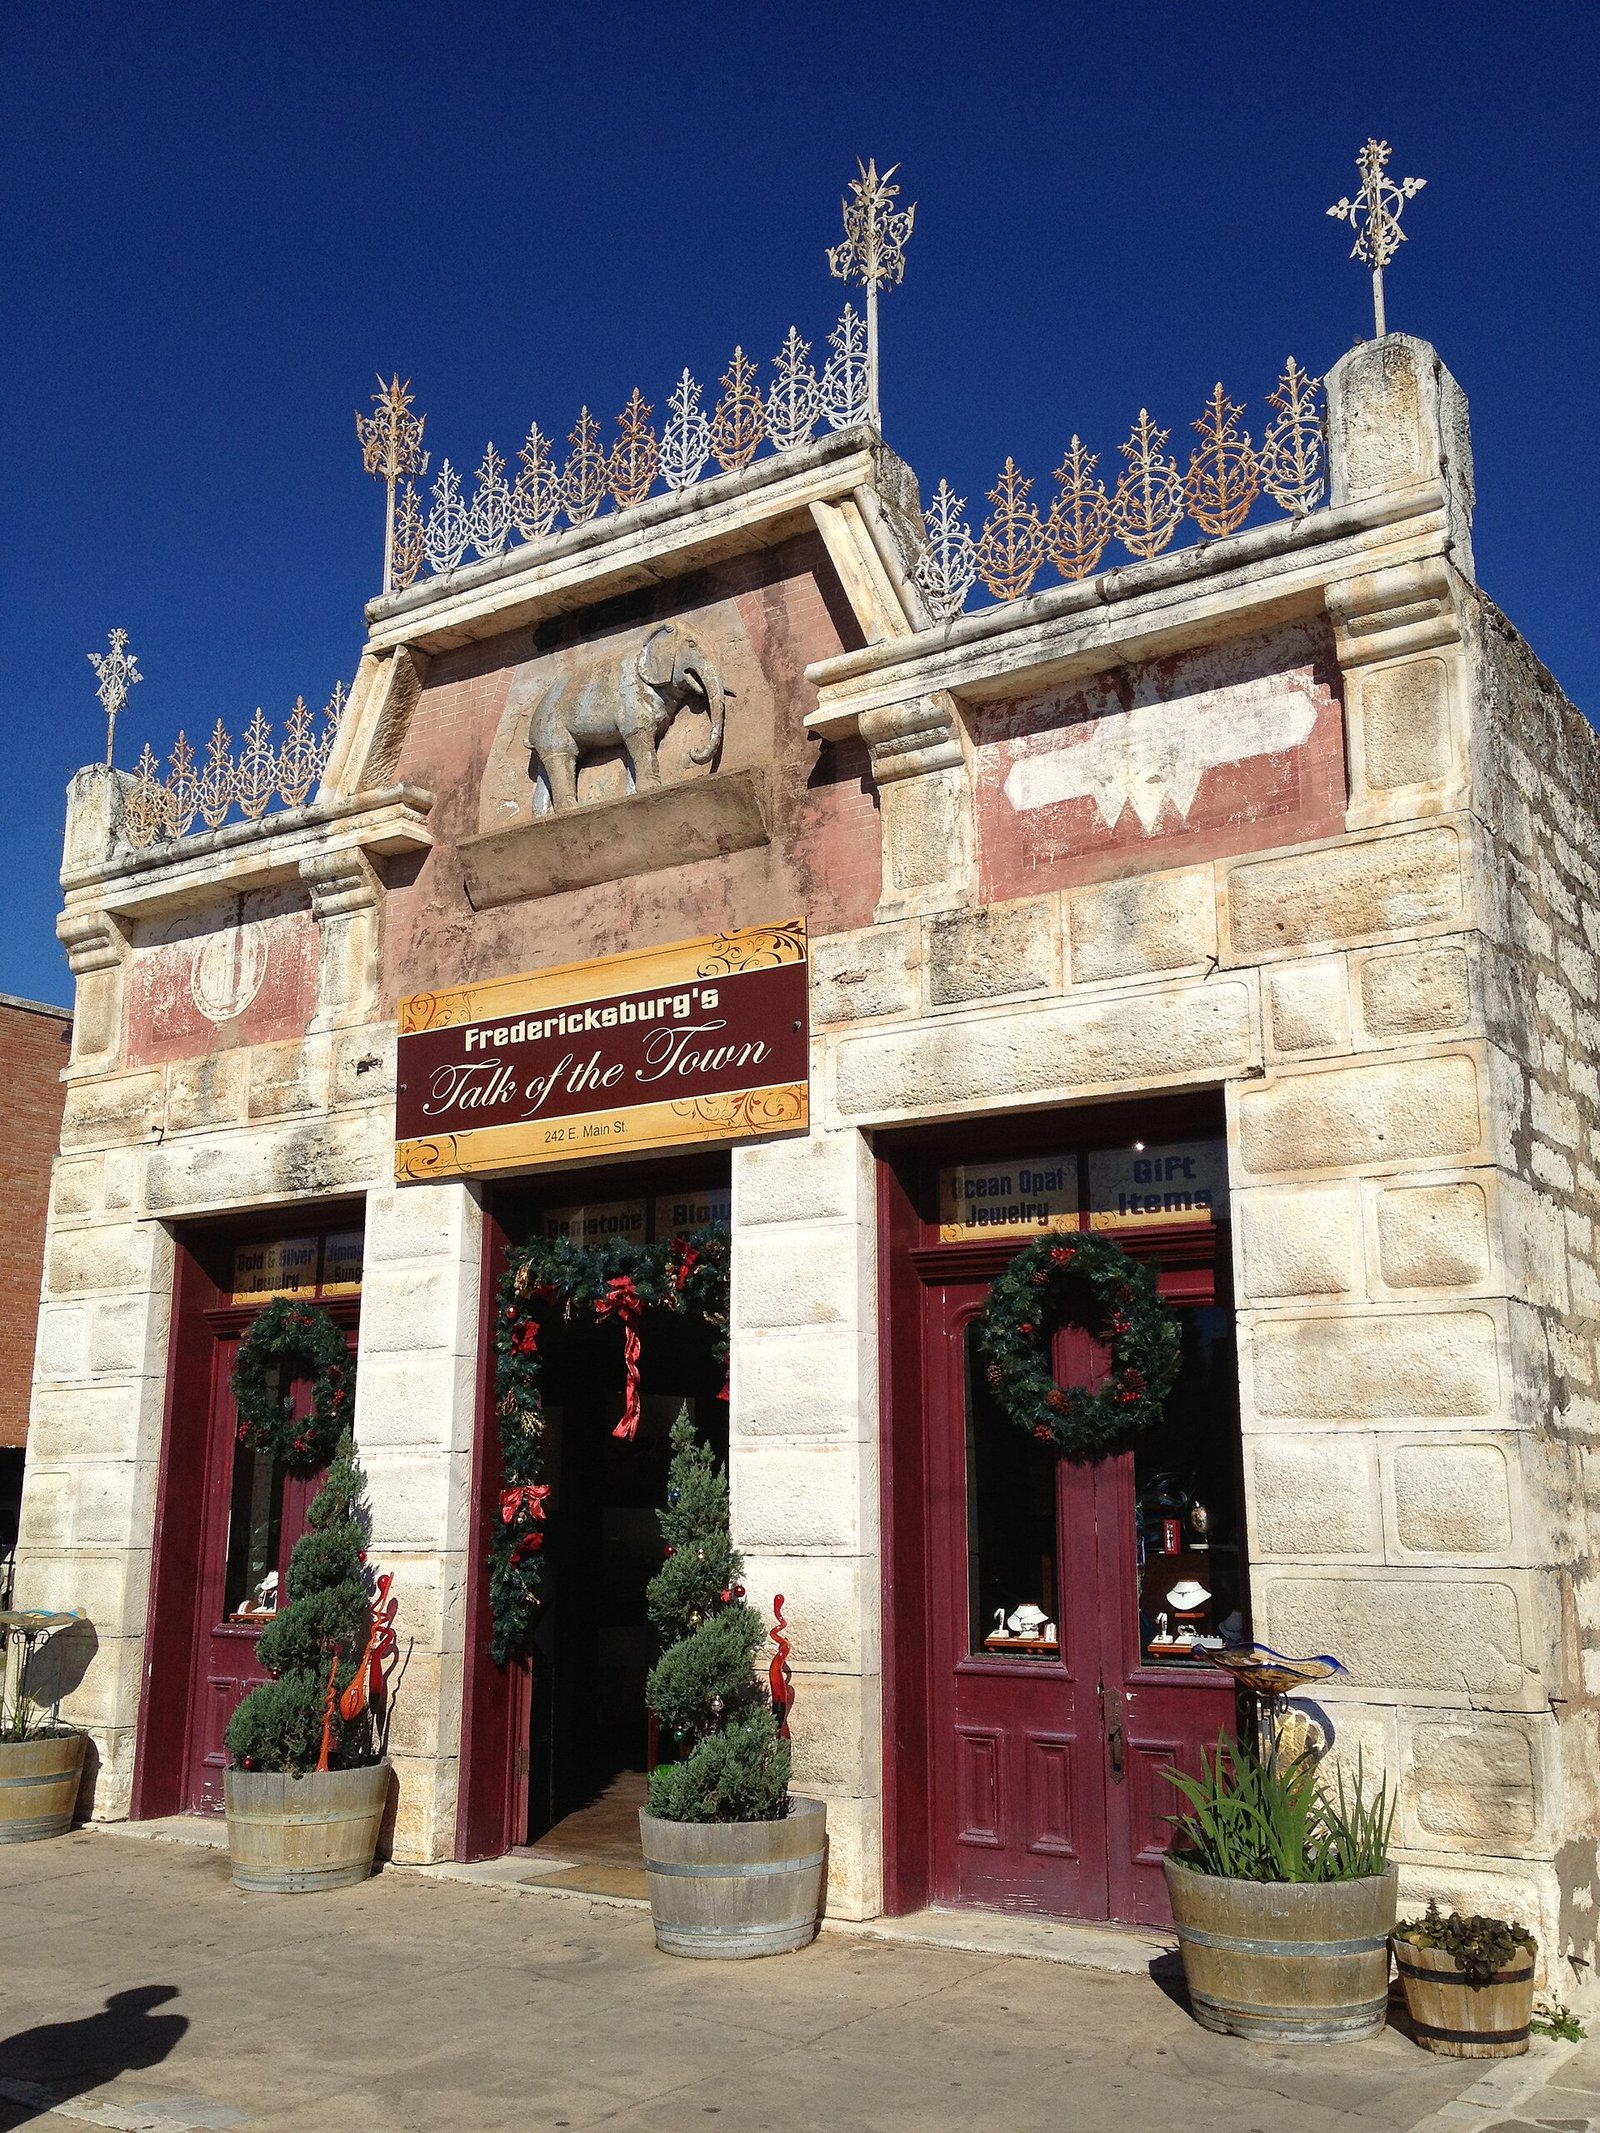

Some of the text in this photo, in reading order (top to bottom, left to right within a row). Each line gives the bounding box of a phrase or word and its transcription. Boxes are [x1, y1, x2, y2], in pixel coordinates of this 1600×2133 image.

[465, 987, 719, 1052] Fredericksburg's
[422, 1019, 772, 1117] Talk of the Town
[544, 1120, 628, 1143] 242 E. Main St.
[1018, 1167, 1064, 1197] Opal
[1133, 1155, 1197, 1184] Gift
[965, 1202, 1049, 1228] Jewelry
[1118, 1189, 1213, 1216] Items
[238, 1250, 264, 1272] Gold
[279, 1247, 313, 1267] Silver
[248, 1273, 300, 1292] Jewelry
